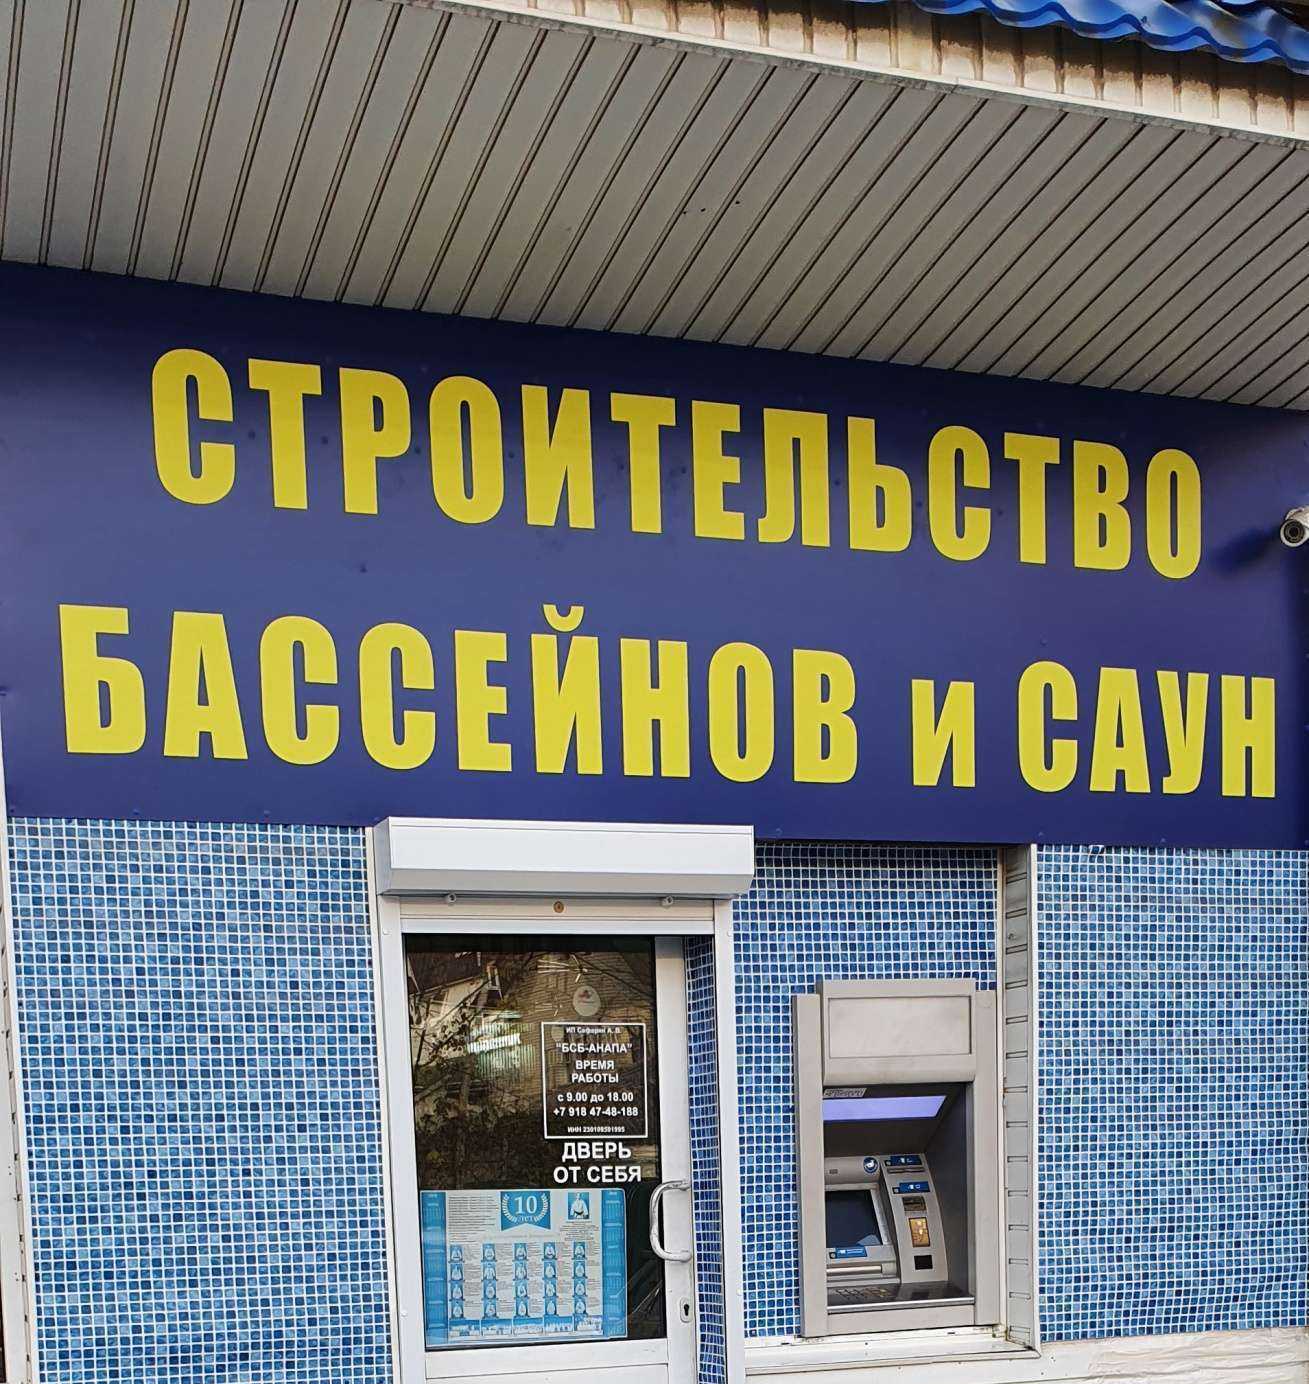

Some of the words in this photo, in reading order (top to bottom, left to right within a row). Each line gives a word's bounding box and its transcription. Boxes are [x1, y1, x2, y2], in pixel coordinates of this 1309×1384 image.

[150, 347, 1203, 579] СТРОИТЕЛЬСТВО
[59, 604, 857, 785] БАССЕЙНОВ
[911, 679, 976, 788] и
[1018, 661, 1276, 798] САУН
[575, 1060, 615, 1070] ВРЕМЯ
[571, 1073, 619, 1083] РАБОТЫ
[557, 1094, 564, 1102] с
[566, 1092, 588, 1102] 9.00
[590, 1094, 604, 1103] до
[607, 1092, 634, 1102] 18.00
[553, 1106, 566, 1117] +7
[568, 1106, 587, 1117] 918
[589, 1106, 639, 1117] 47-48-188
[562, 1142, 632, 1163] ДВЕРЬ
[553, 1166, 581, 1184] ОТ
[587, 1165, 642, 1183] СЕБЯ
[514, 1195, 537, 1215] 10
